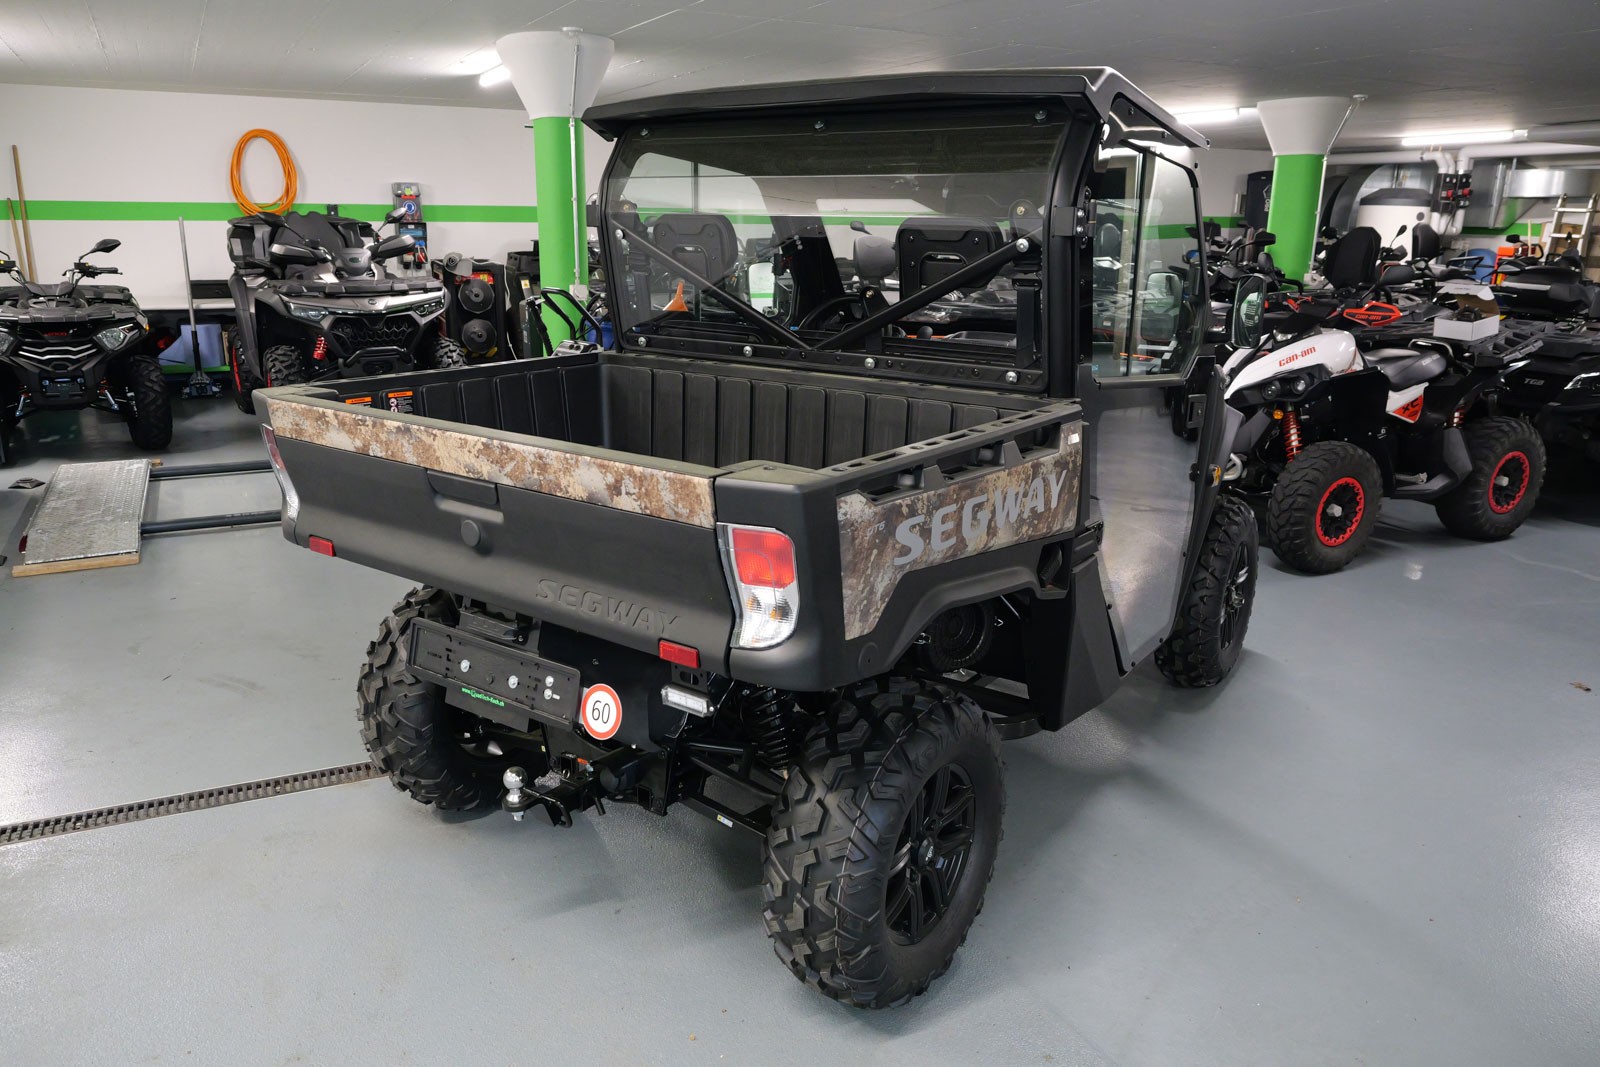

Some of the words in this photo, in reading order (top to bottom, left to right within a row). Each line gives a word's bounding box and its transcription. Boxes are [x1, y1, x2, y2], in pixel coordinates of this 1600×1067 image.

[1278, 346, 1317, 368] can-am
[893, 469, 1067, 566] SEGWAY
[535, 578, 682, 636] SEGWAY
[592, 700, 611, 724] 60
